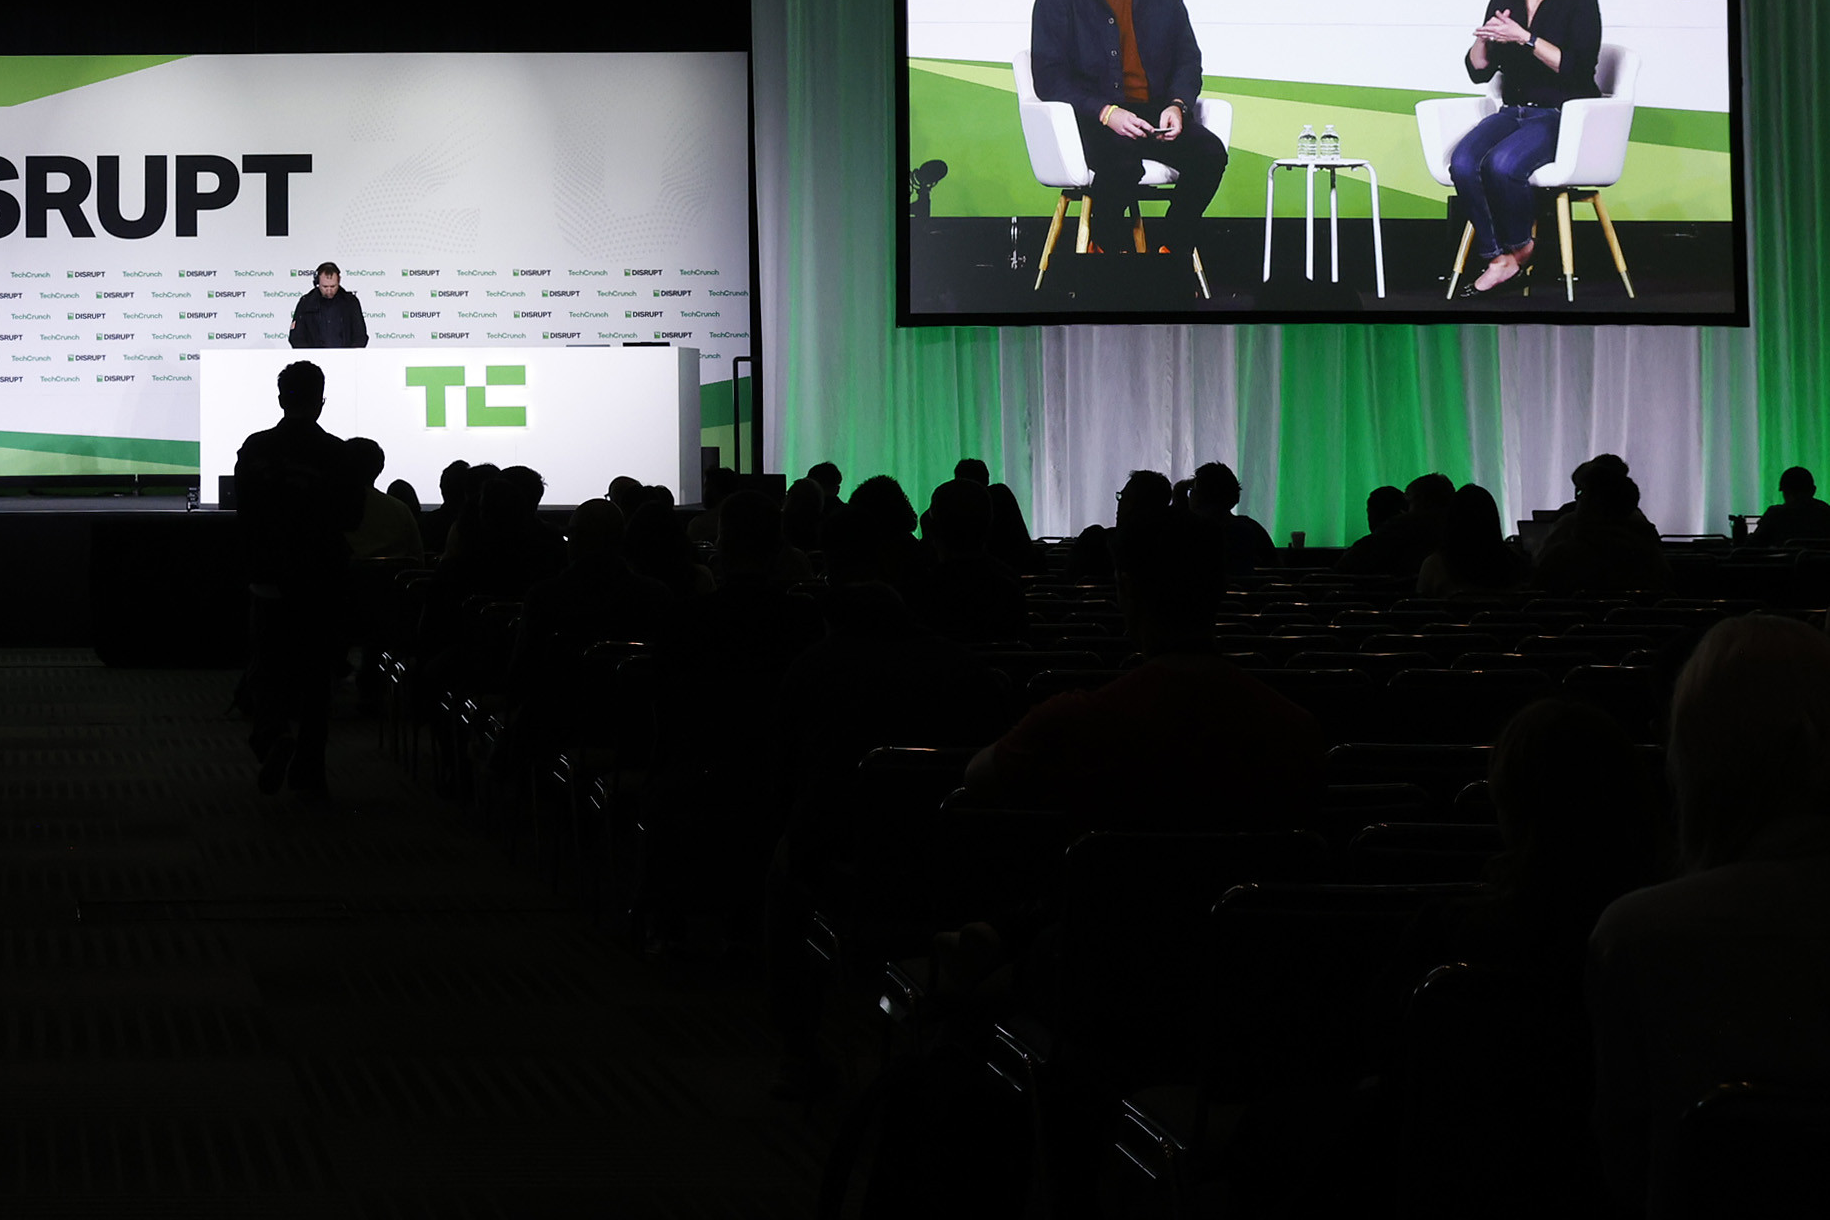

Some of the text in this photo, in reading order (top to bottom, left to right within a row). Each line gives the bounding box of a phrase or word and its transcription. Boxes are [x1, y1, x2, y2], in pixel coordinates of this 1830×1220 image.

[10, 271, 51, 279] TechCrunch
[185, 270, 218, 278] DISRUPT
[234, 269, 275, 277] TechCrunch
[345, 269, 386, 277] TechCrunch
[457, 269, 498, 277] TechCrunch
[680, 268, 720, 276] TechCrunch
[40, 292, 81, 300] TechCrunch
[374, 290, 415, 298] TechCrunch
[486, 290, 527, 298] TechCrunch
[597, 289, 638, 298] TechCrunch
[708, 289, 749, 297] TechCrunch
[11, 313, 52, 321] TechCrunch
[234, 311, 275, 319] TechCrunch
[409, 311, 442, 319] DISRUPT
[681, 310, 721, 318] TechCrunch
[40, 333, 81, 341] TechCrunch
[215, 332, 248, 340] DISRUPT
[487, 332, 527, 340] TechCrunch
[708, 331, 750, 339] TechCrunch
[11, 354, 52, 362] TechCrunch
[40, 375, 81, 383] TechCrunch
[152, 374, 193, 382] TechCrunch
[405, 365, 527, 427] TC
